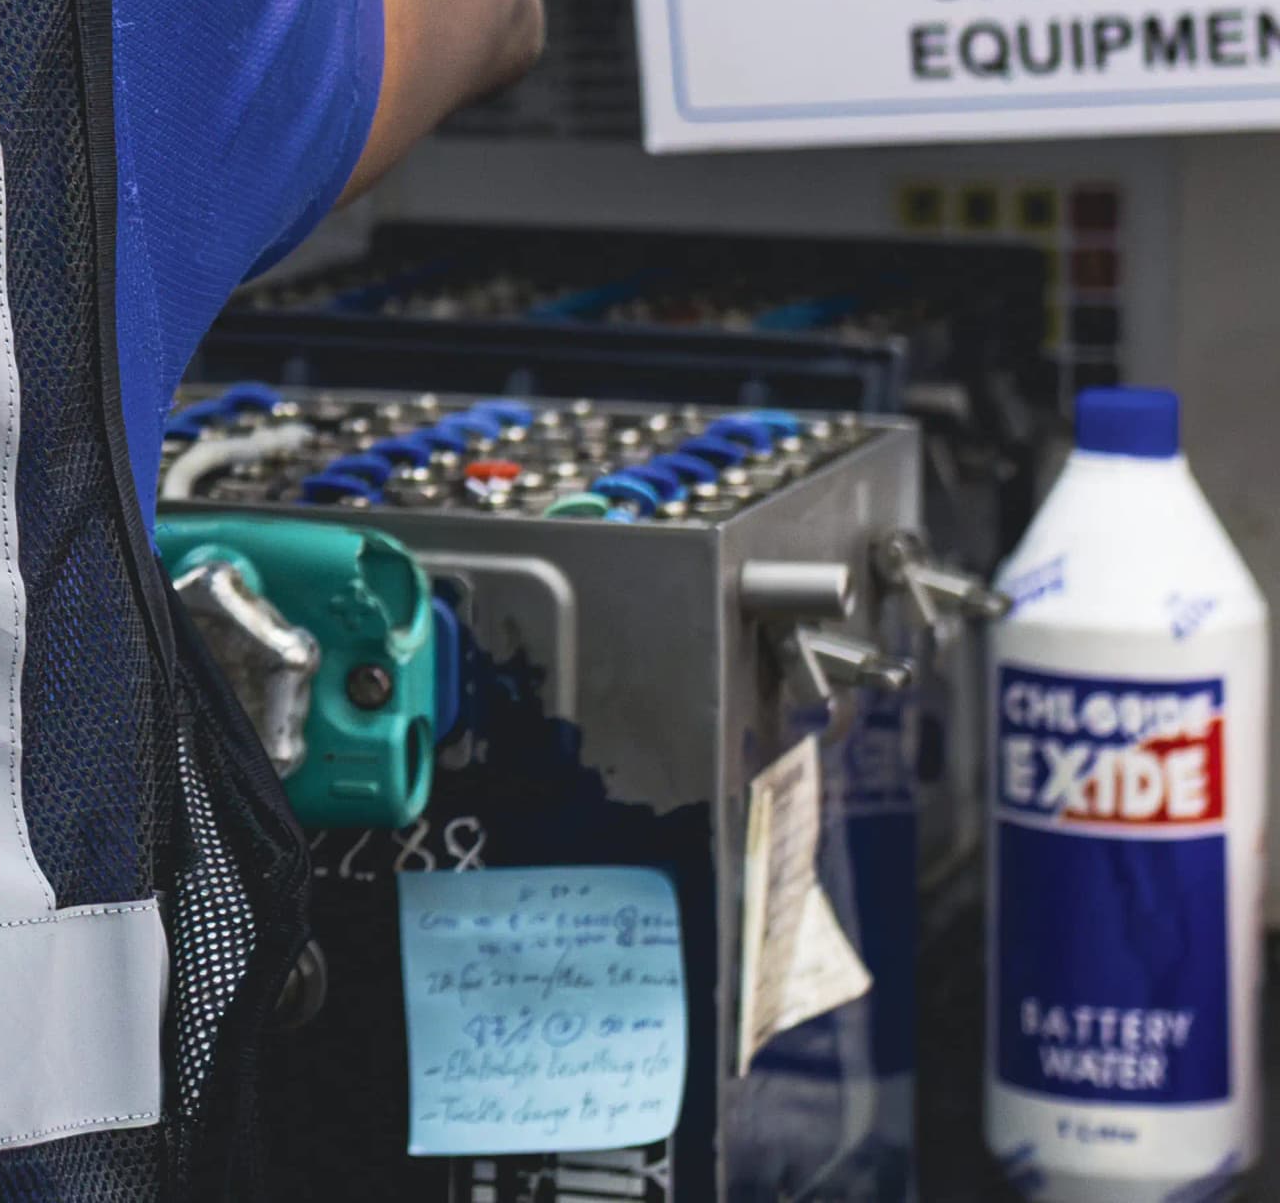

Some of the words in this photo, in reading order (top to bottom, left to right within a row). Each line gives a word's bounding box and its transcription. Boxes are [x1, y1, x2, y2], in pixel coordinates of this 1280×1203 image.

[1005, 738, 1208, 819] EXIDE
[1020, 997, 1194, 1049] BATTERY
[1040, 1047, 1168, 1090] WATER
